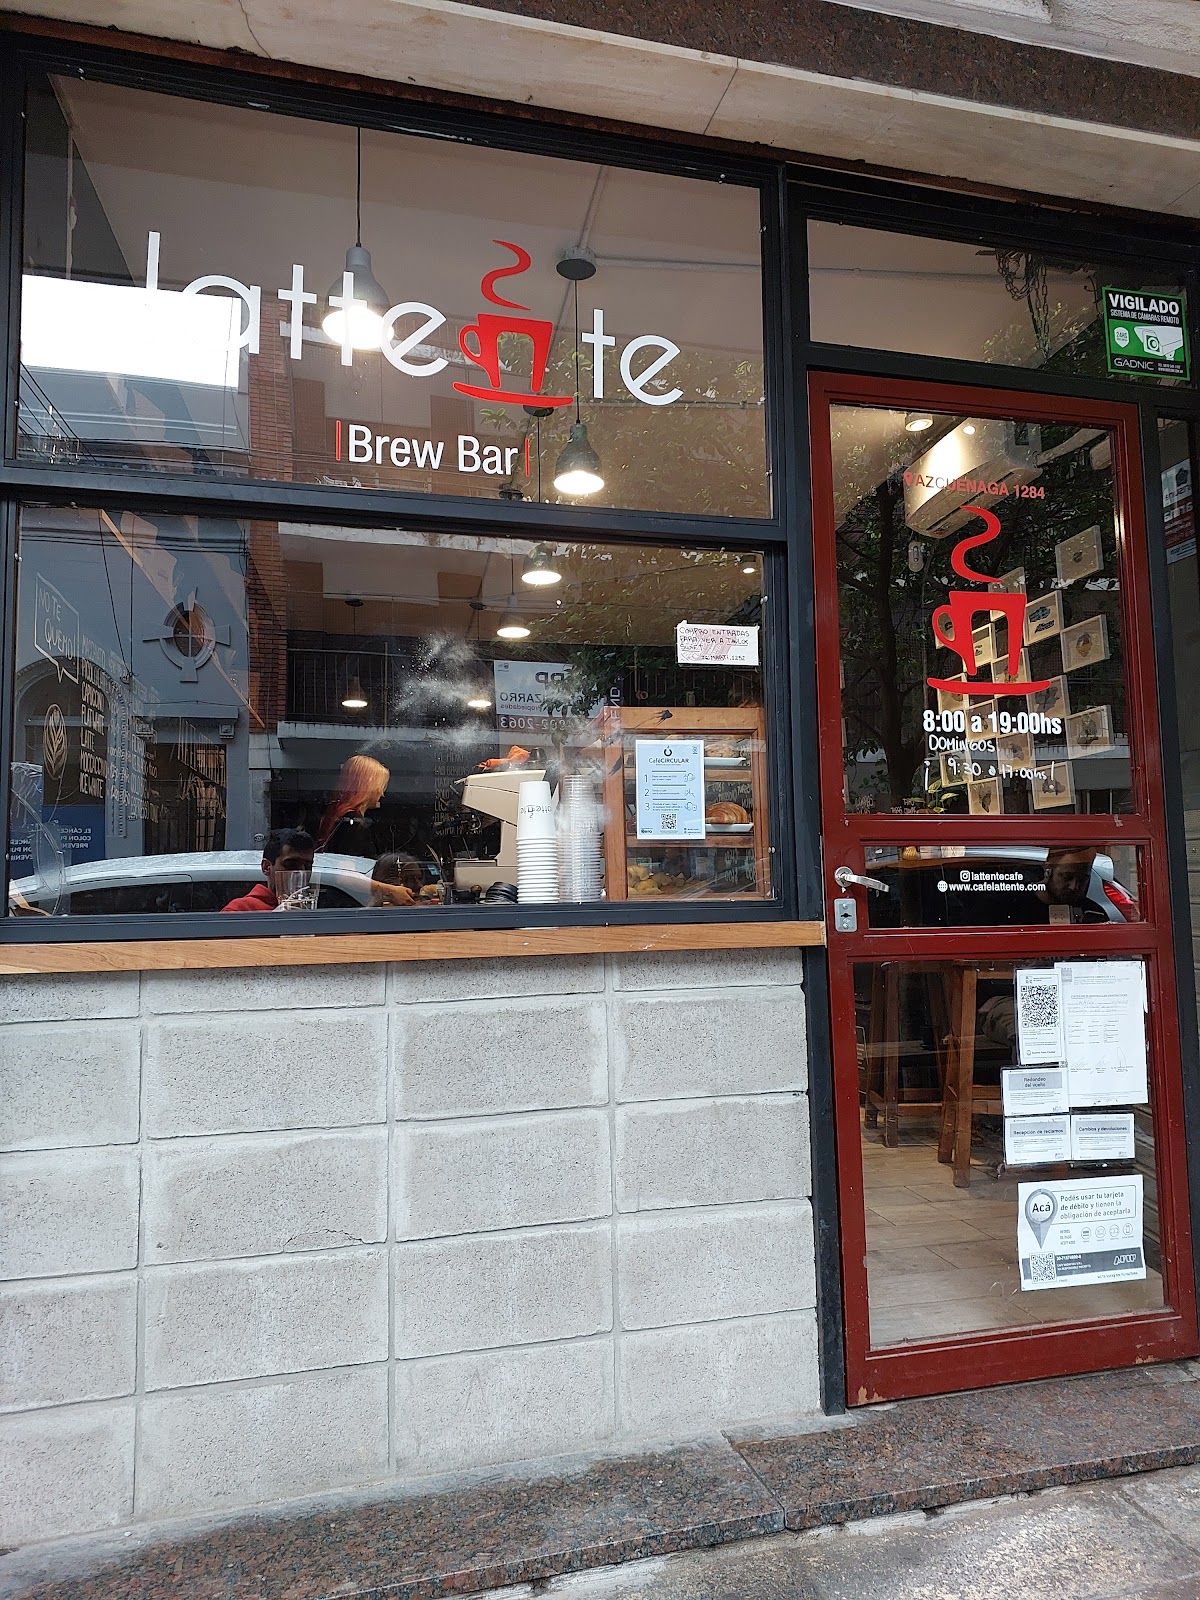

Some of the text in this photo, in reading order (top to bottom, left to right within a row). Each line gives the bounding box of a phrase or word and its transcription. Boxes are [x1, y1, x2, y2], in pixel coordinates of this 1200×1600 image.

[1108, 292, 1180, 315] VIGILADO
[1110, 308, 1131, 318] SISTEMA
[1131, 311, 1138, 319] DE
[1160, 315, 1180, 325] REMOTO
[1113, 357, 1155, 371] GADNIC
[348, 424, 519, 475] Brew Bar
[1013, 484, 1046, 500] 1284
[679, 626, 750, 637] COMPRO ENTRADAS
[922, 709, 1063, 735] 8:00 a 19:00hs
[644, 773, 648, 783] 1
[644, 788, 650, 797] 2
[644, 802, 650, 811] 3
[971, 871, 1024, 881] lattentecafe
[948, 881, 1047, 892] www.cafelattente.com
[1013, 1129, 1037, 1137] Recepción
[1060, 1193, 1080, 1202] Podés
[1103, 1191, 1125, 1201] tarjeta
[1031, 1201, 1051, 1214] Acá
[1060, 1203, 1069, 1211] de
[1069, 1202, 1089, 1211] débito
[1060, 1211, 1093, 1221] obligación
[1102, 1207, 1131, 1218] aceptarla
